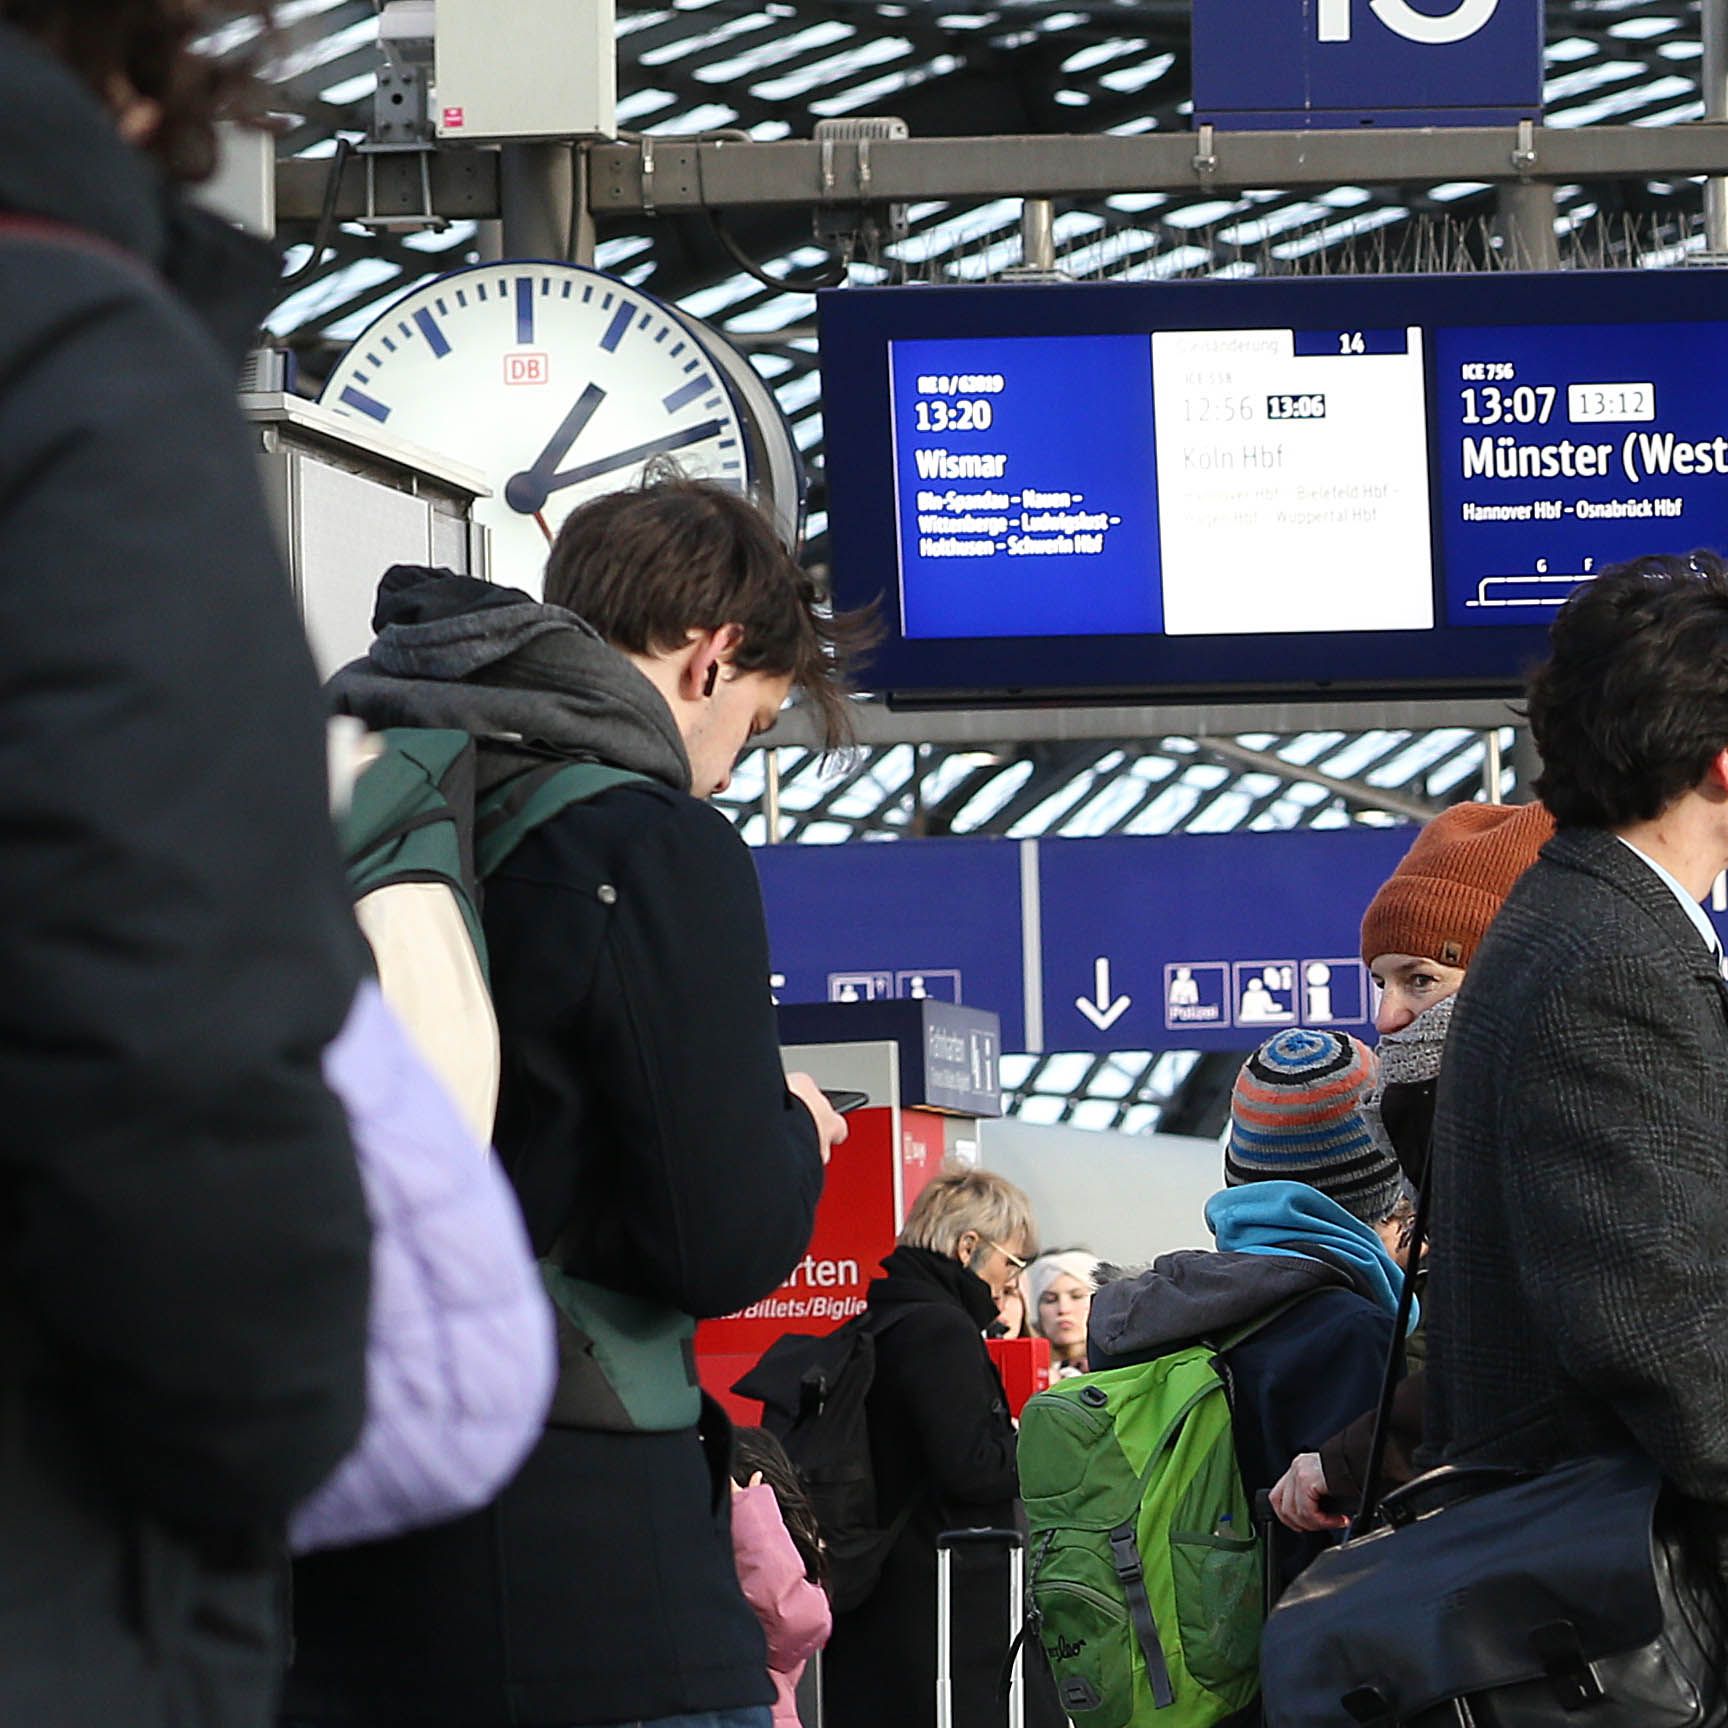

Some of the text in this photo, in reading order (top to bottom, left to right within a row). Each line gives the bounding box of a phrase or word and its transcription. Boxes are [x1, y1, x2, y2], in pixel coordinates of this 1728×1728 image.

[1338, 332, 1365, 354] 14
[511, 359, 541, 380] DB
[1461, 363, 1514, 381] ICE 756
[915, 399, 992, 431] 13:20
[1183, 395, 1325, 423] 12:56 13:06
[1461, 386, 1645, 424] 13:07 13:12
[915, 449, 1007, 479] Wismar
[1243, 443, 1284, 469] Hbf
[1462, 436, 1612, 478] Münster
[1463, 503, 1532, 521] Hannover
[1534, 501, 1562, 520] Hbf
[1576, 499, 1653, 519] Osnabrück
[1654, 498, 1683, 518] Hbf
[784, 1254, 858, 1288] rten
